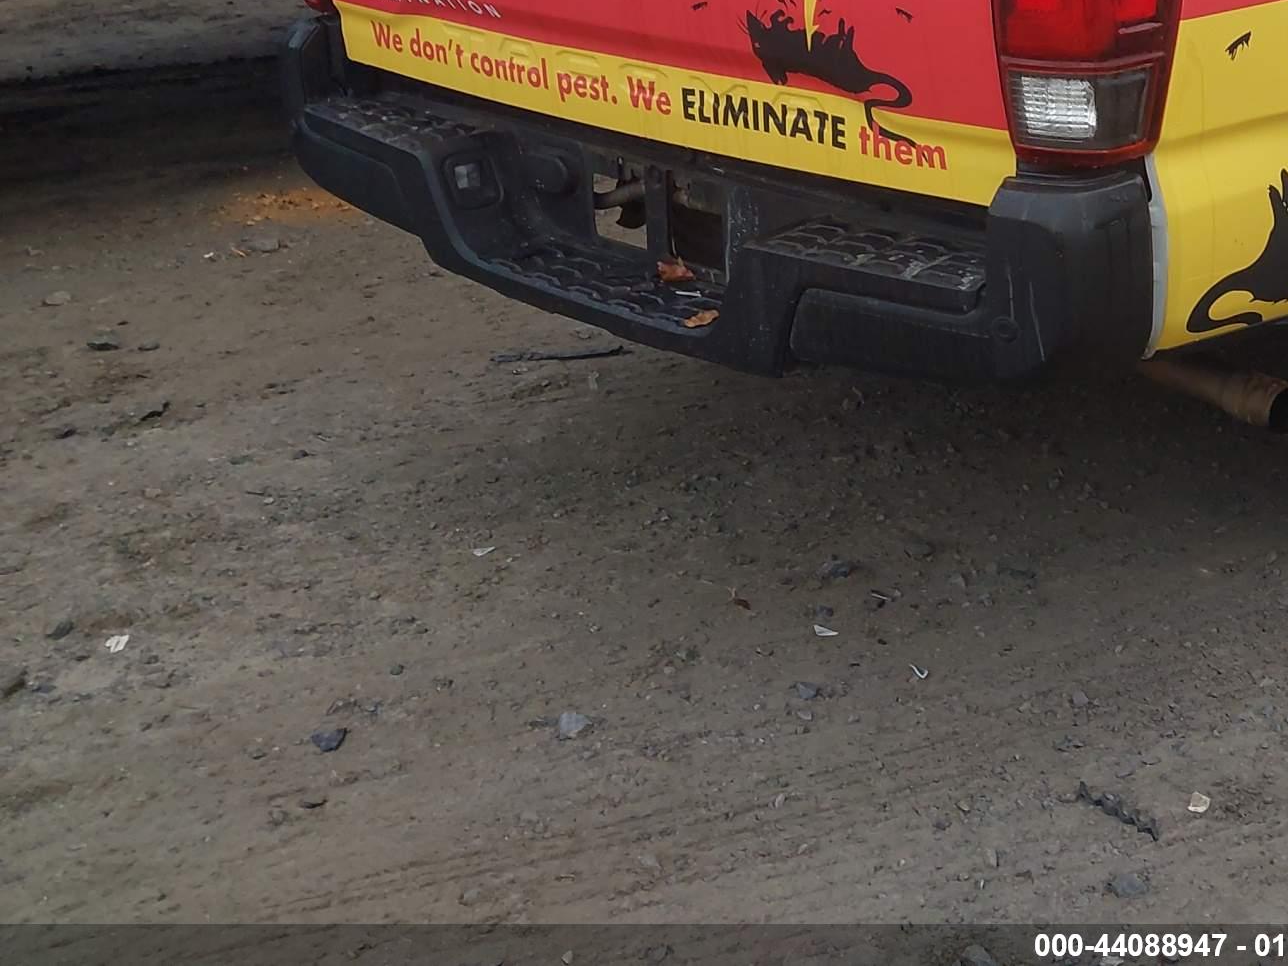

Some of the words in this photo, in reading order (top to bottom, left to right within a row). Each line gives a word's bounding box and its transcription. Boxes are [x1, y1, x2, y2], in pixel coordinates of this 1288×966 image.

[371, 20, 404, 53] We
[409, 28, 464, 69] don't
[469, 57, 549, 90] control
[557, 71, 618, 105] pest.
[626, 74, 672, 115] We
[681, 87, 847, 150] ELIMINATE
[858, 121, 948, 171] them
